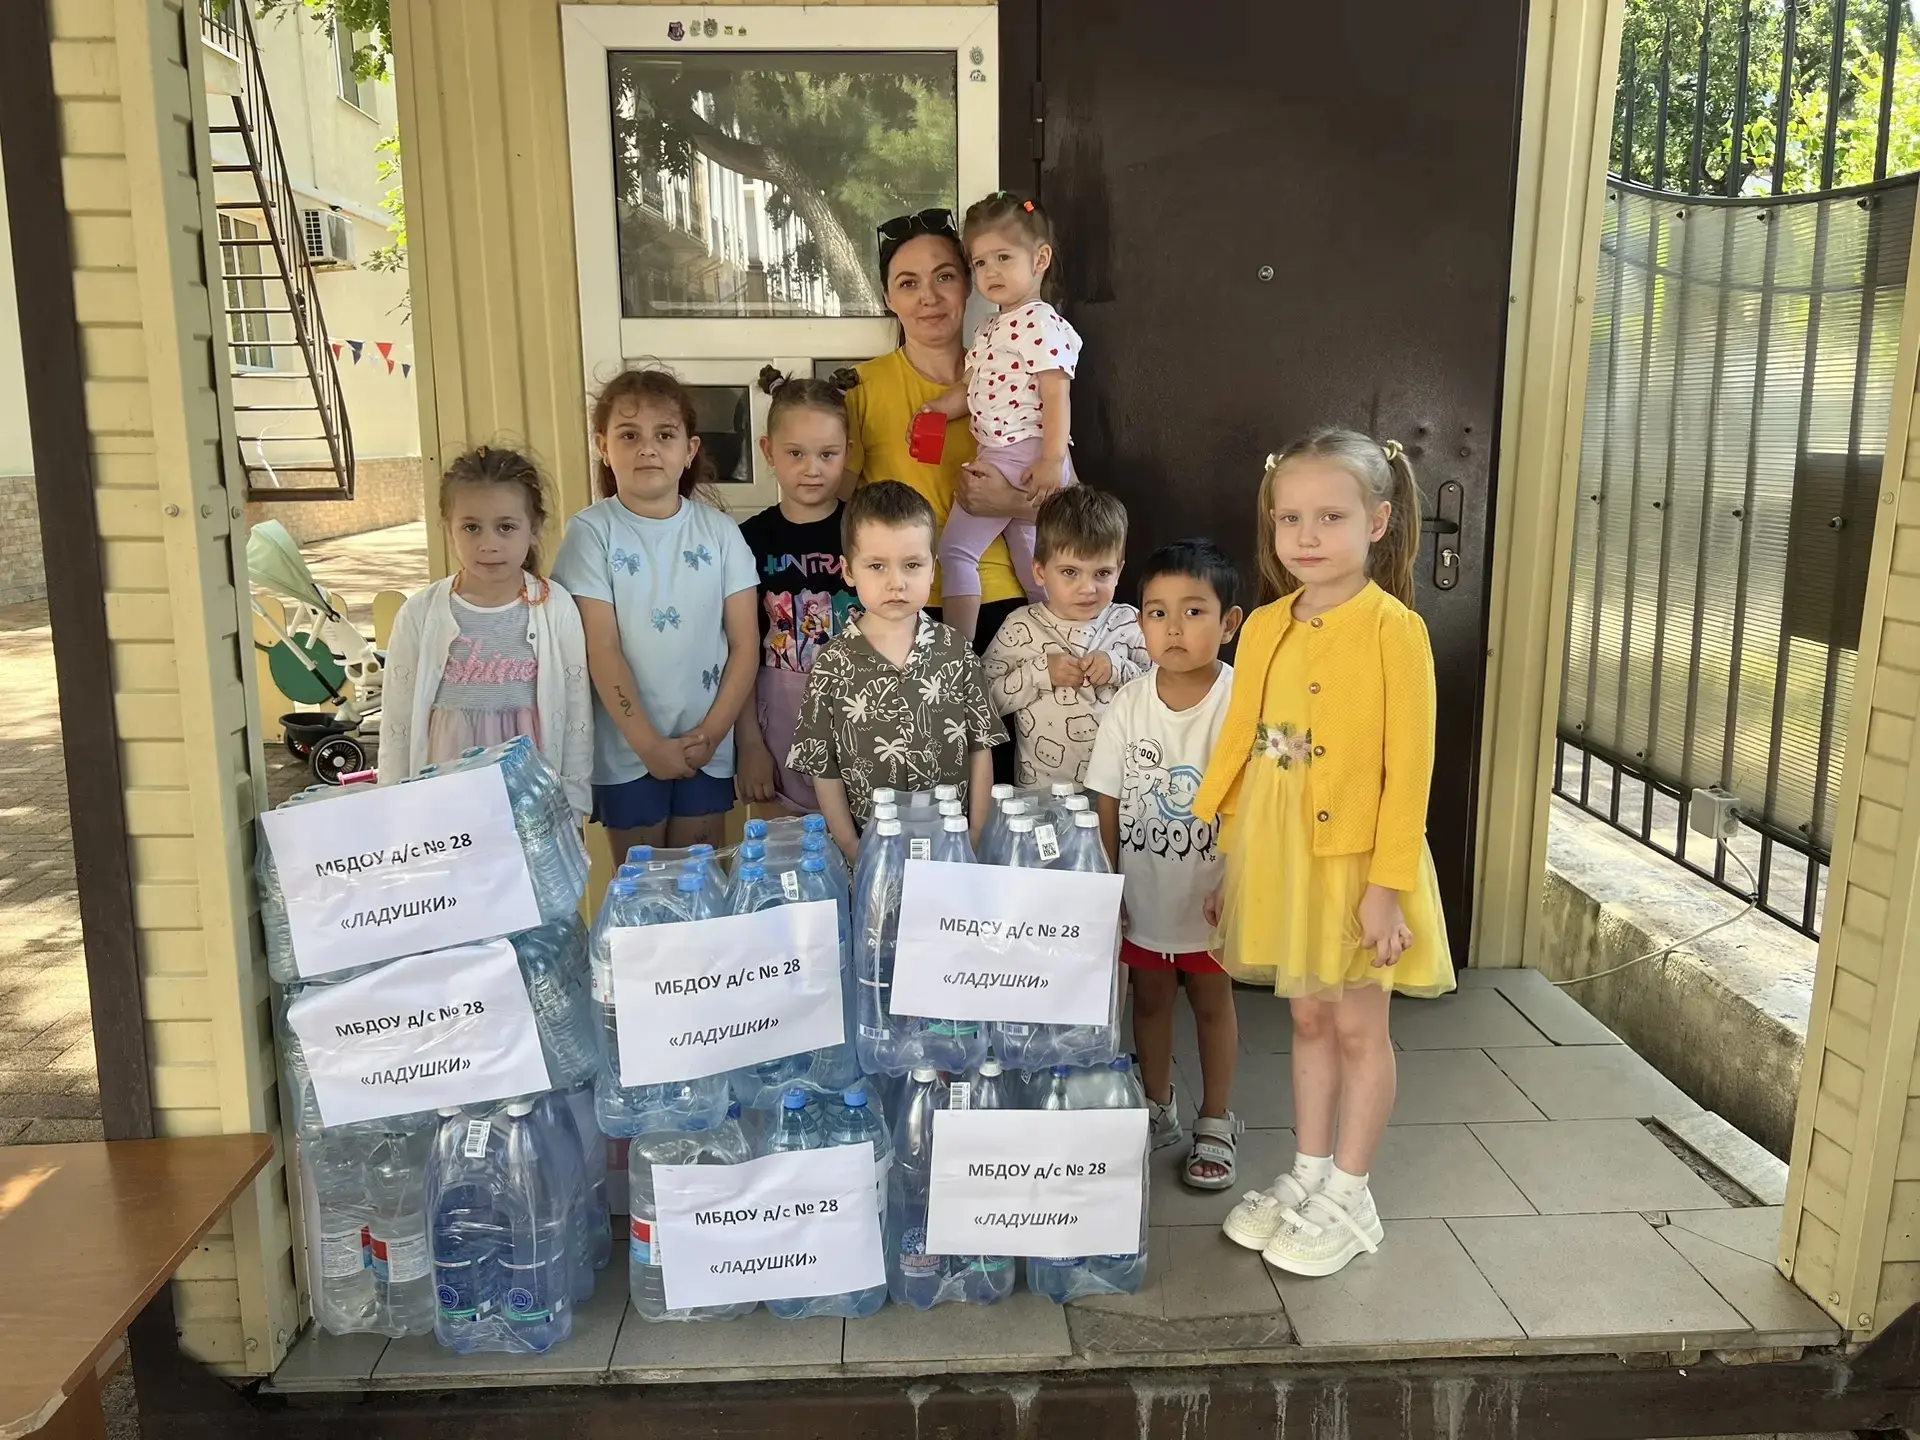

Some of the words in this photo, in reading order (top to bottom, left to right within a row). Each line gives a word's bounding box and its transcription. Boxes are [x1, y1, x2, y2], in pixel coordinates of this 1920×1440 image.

[1138, 748, 1156, 764] OOL
[315, 849, 385, 877] МБДОУ
[391, 843, 421, 865] д/с
[423, 840, 447, 855] №
[450, 833, 473, 850] 28
[340, 895, 457, 930] «ЛАДУШКИ»
[939, 917, 1002, 936] МБДОУ
[1006, 922, 1034, 939] д/с
[1038, 924, 1057, 938] №
[1060, 924, 1080, 938] 28
[654, 973, 722, 996] МБДОУ
[726, 968, 755, 989] д/с
[759, 964, 779, 980] №
[783, 958, 801, 975] 28
[943, 972, 1049, 989] «ЛАДУШКИ»
[335, 1015, 401, 1037] МБДОУ
[407, 1009, 436, 1029] д/с
[439, 1005, 460, 1021] №
[463, 1000, 485, 1015] 28
[668, 1017, 780, 1047] «ЛАДУШКИ»
[360, 1057, 471, 1086] «ЛАДУШКИ»
[968, 1163, 1031, 1180] МБДОУ
[1033, 1163, 1062, 1179] д/с
[1065, 1163, 1084, 1176] №
[1088, 1162, 1107, 1175] 28
[695, 1208, 758, 1226] МБДОУ
[763, 1204, 791, 1222] д/с
[795, 1203, 814, 1217] №
[819, 1199, 839, 1213] 28
[974, 1212, 1078, 1228] «ЛАДУШКИ»
[710, 1252, 817, 1275] «ЛАДУШКИ»
